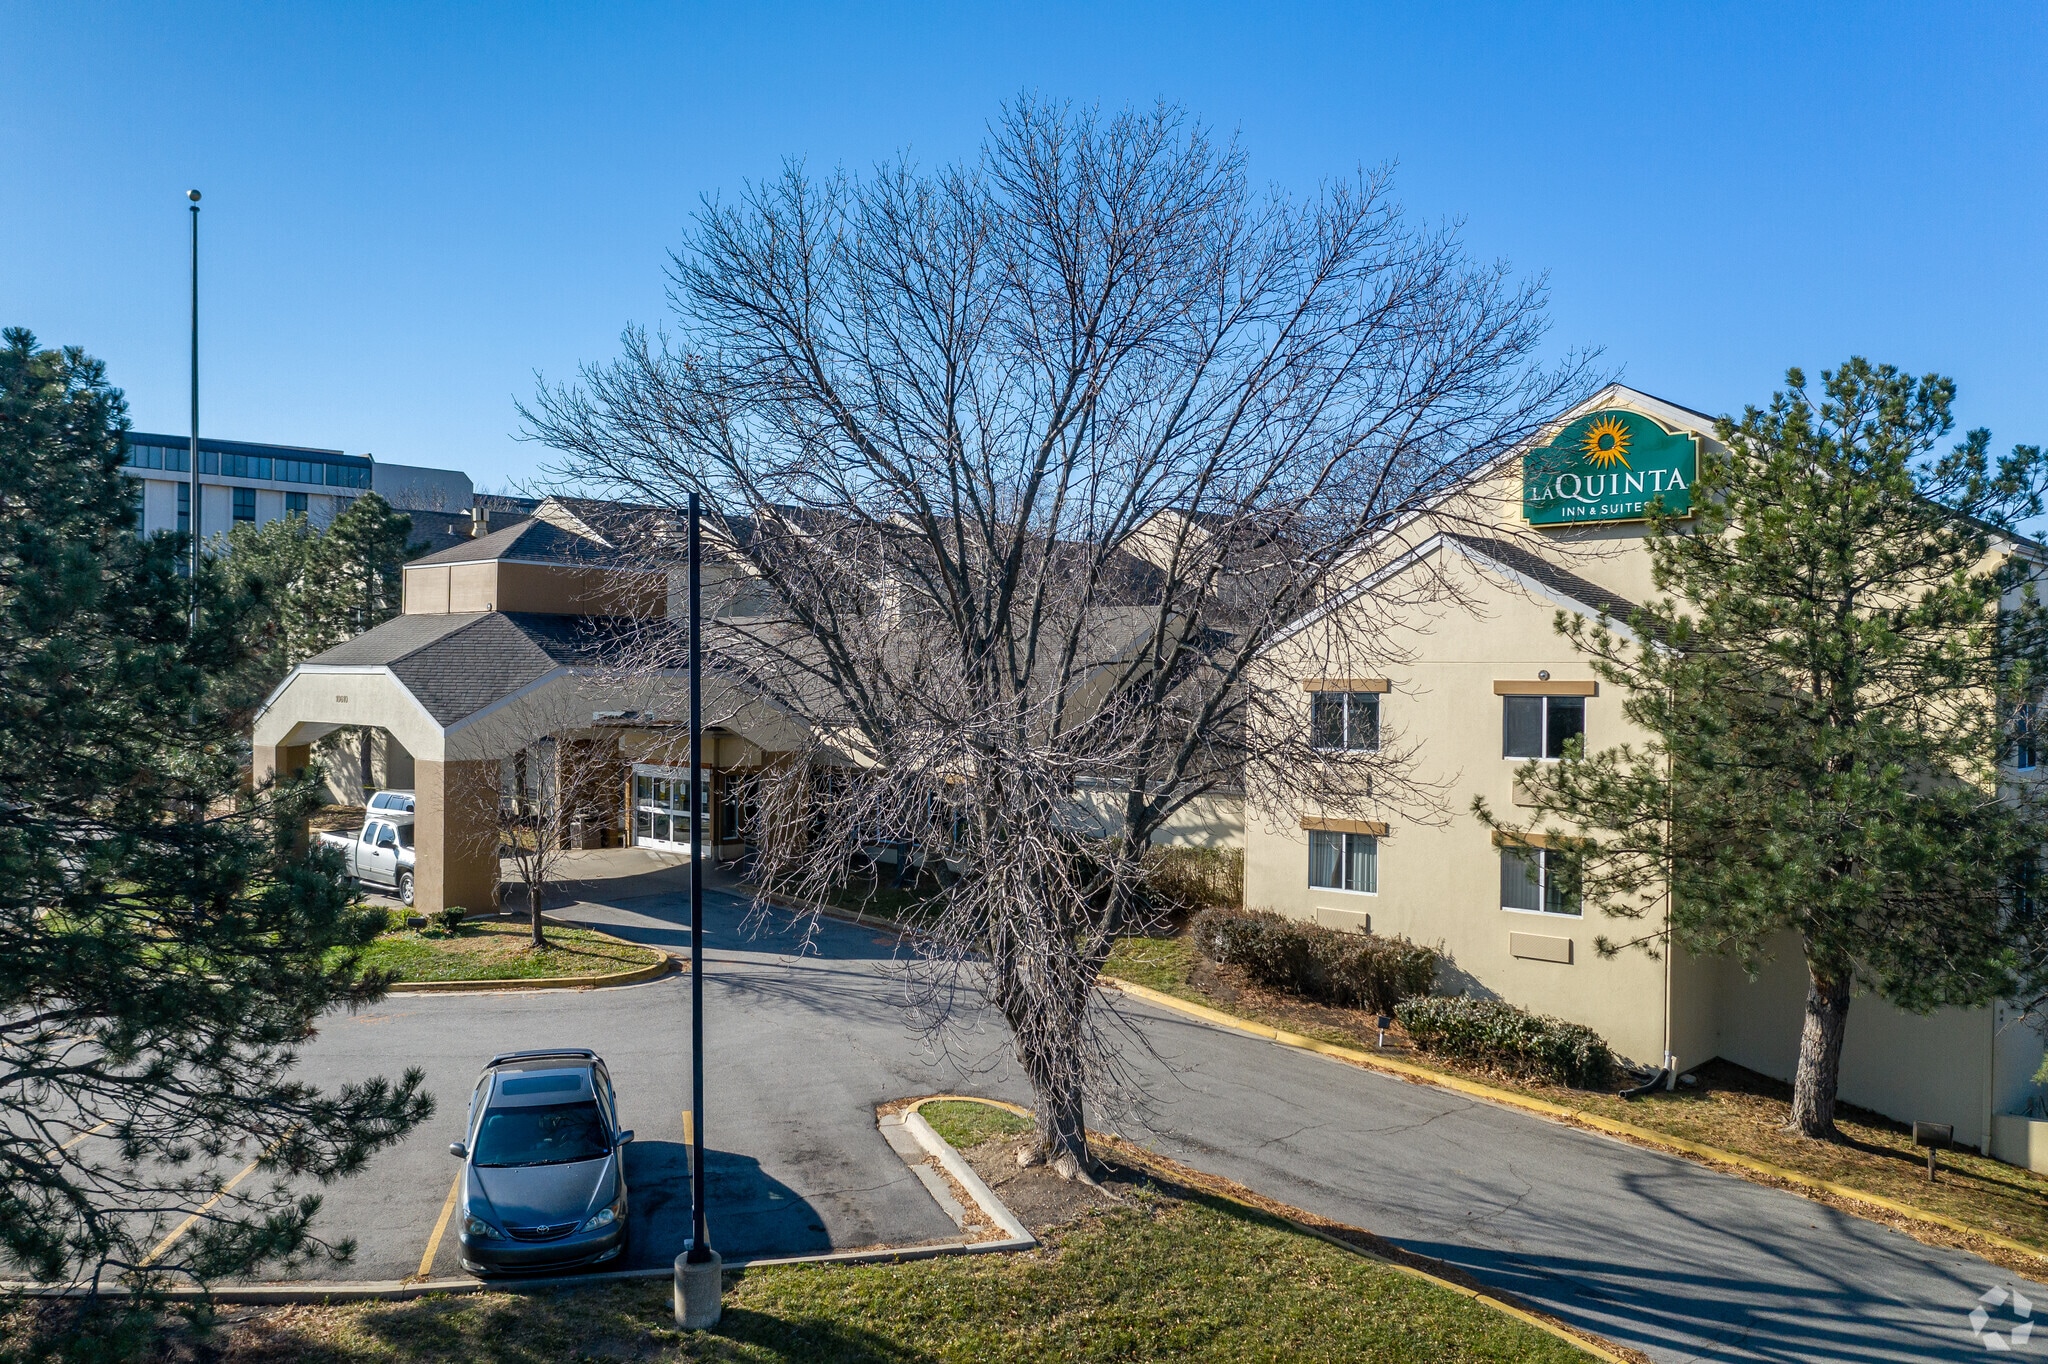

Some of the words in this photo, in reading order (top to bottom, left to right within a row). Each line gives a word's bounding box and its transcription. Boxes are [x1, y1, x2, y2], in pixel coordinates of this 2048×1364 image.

[1530, 487, 1554, 501] LA
[1555, 467, 1687, 504] QUINTA
[1561, 506, 1585, 517] INN
[1589, 505, 1597, 515] &
